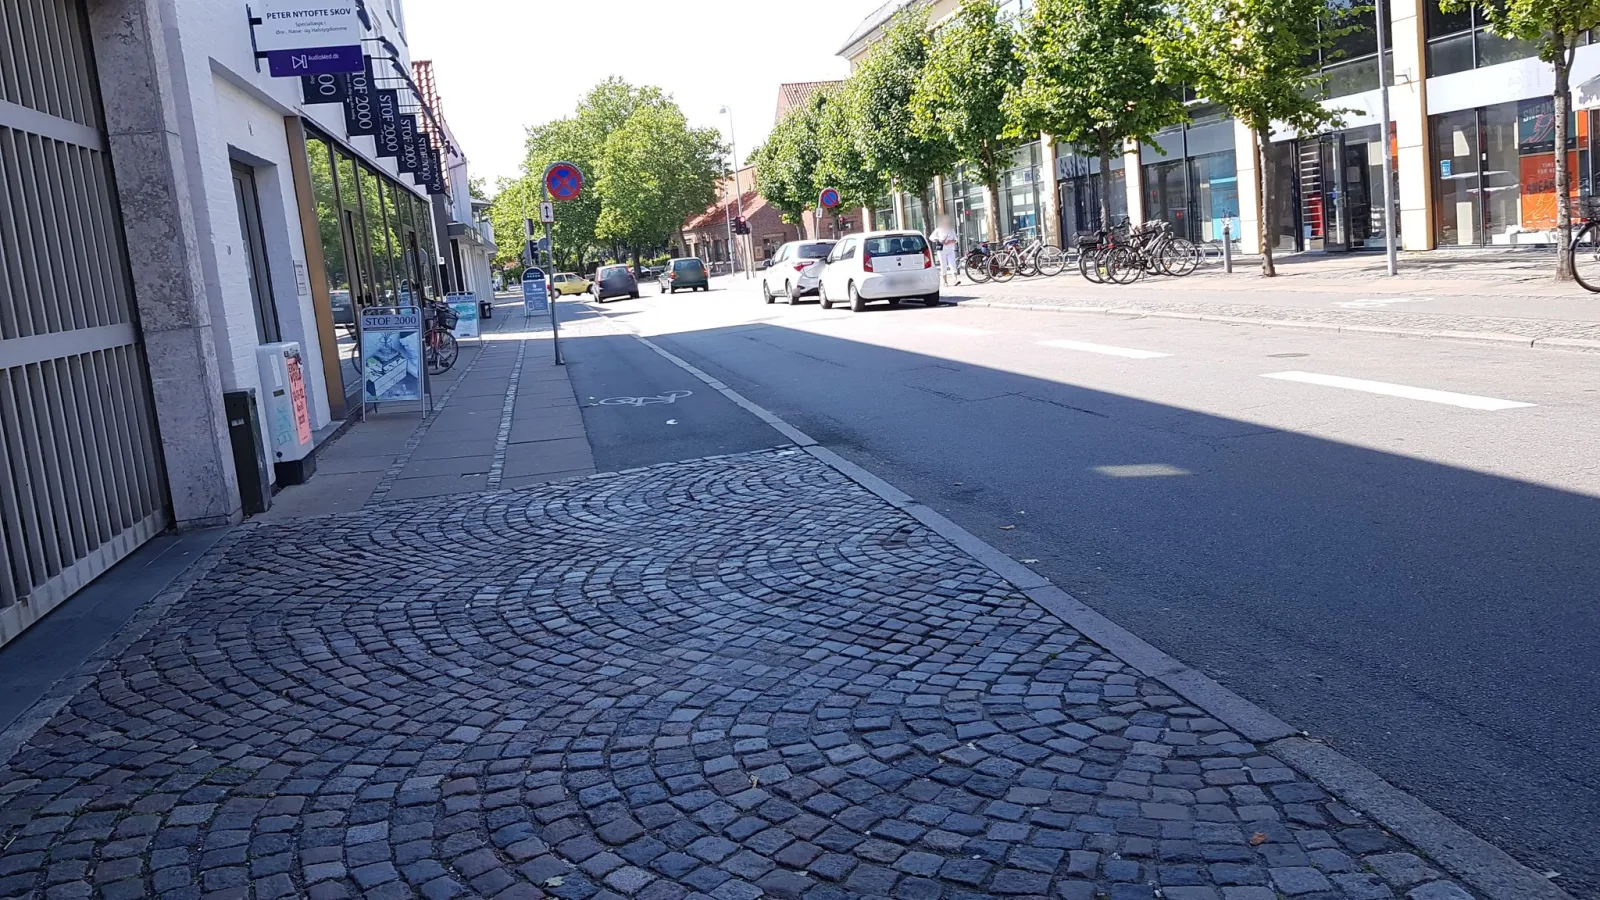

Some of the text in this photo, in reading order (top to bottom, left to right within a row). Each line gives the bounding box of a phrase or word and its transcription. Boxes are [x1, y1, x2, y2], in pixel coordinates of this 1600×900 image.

[266, 7, 351, 20] PETER NYTOFTE SKOV
[308, 53, 339, 61] AudioMed.dk
[352, 72, 373, 129] TOF 2000
[380, 94, 399, 152] STOF 2000
[400, 119, 418, 169] STOF 2000
[365, 316, 417, 326] STOF 2000
